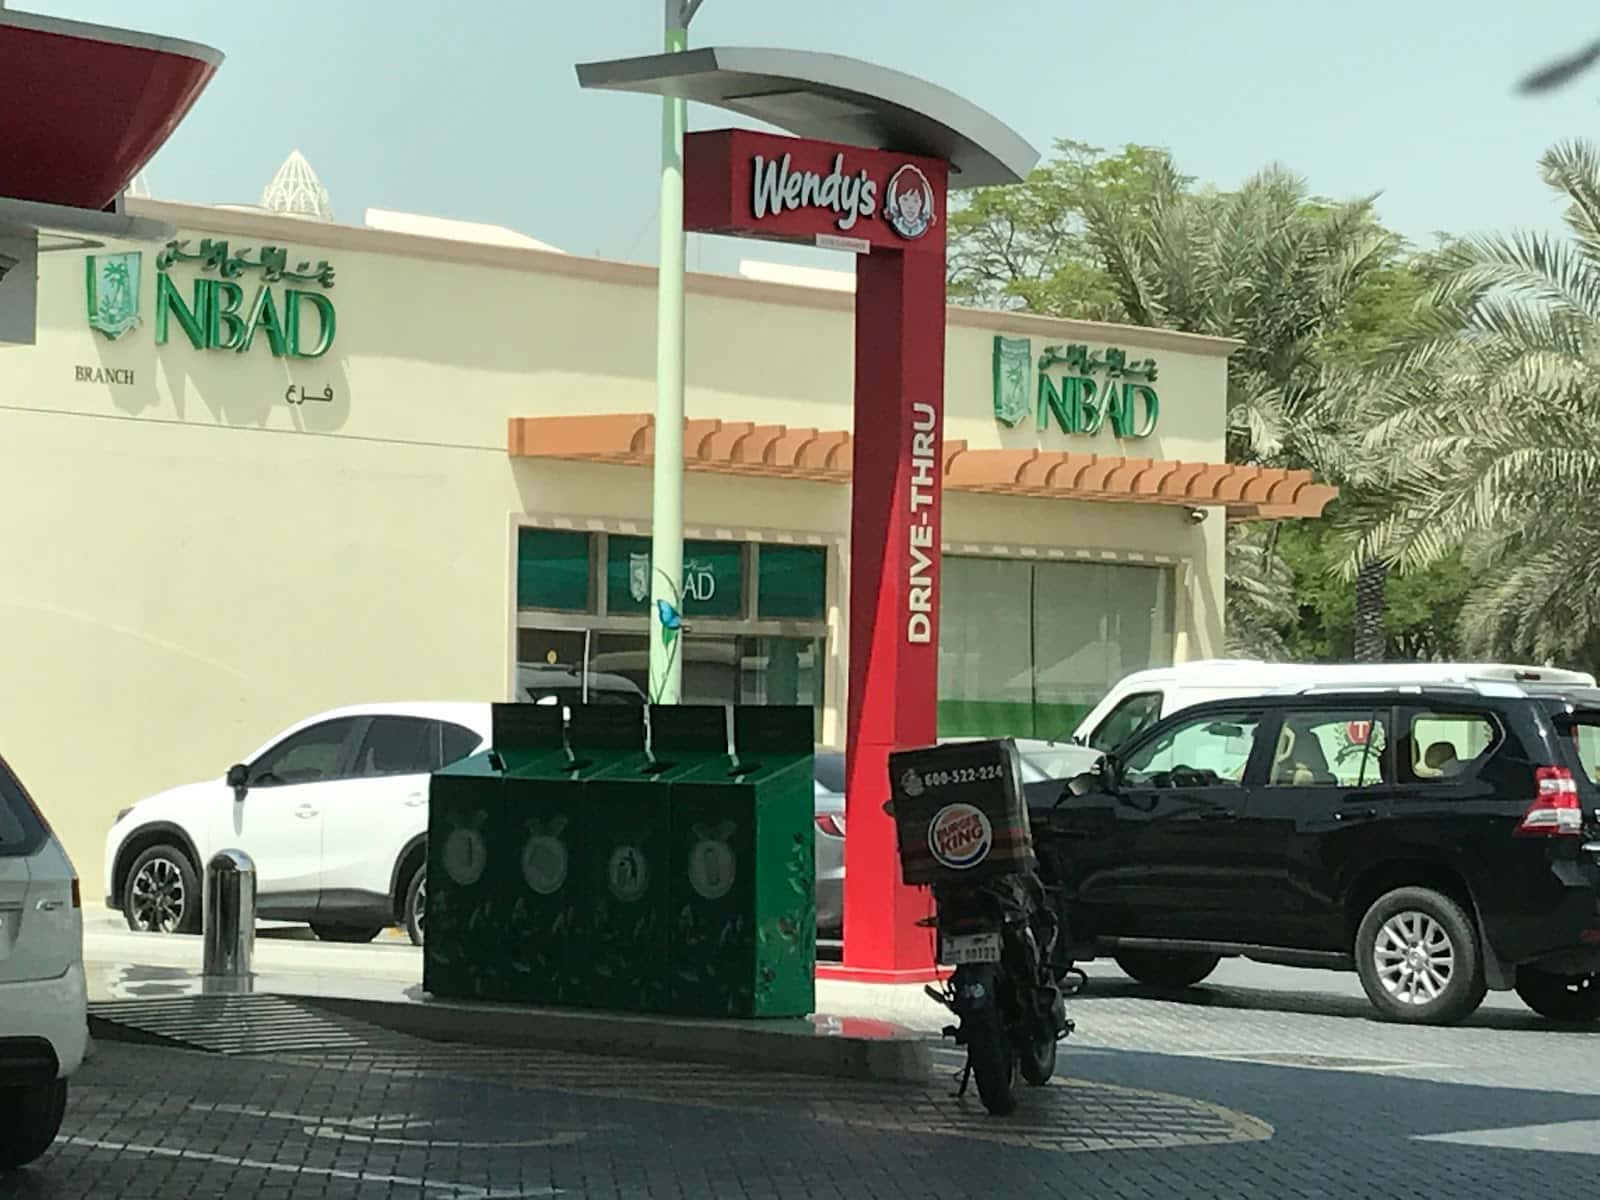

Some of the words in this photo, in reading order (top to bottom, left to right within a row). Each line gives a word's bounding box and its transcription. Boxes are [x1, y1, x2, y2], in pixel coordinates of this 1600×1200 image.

[753, 152, 877, 230] Wendy's
[155, 271, 337, 359] NBAD
[75, 365, 135, 386] BRANCH
[1036, 373, 1160, 439] NBAD
[907, 402, 937, 644] DRIVE-THRU
[682, 572, 715, 601] AD
[924, 764, 1004, 787] 600-522-224
[940, 825, 984, 855] KING
